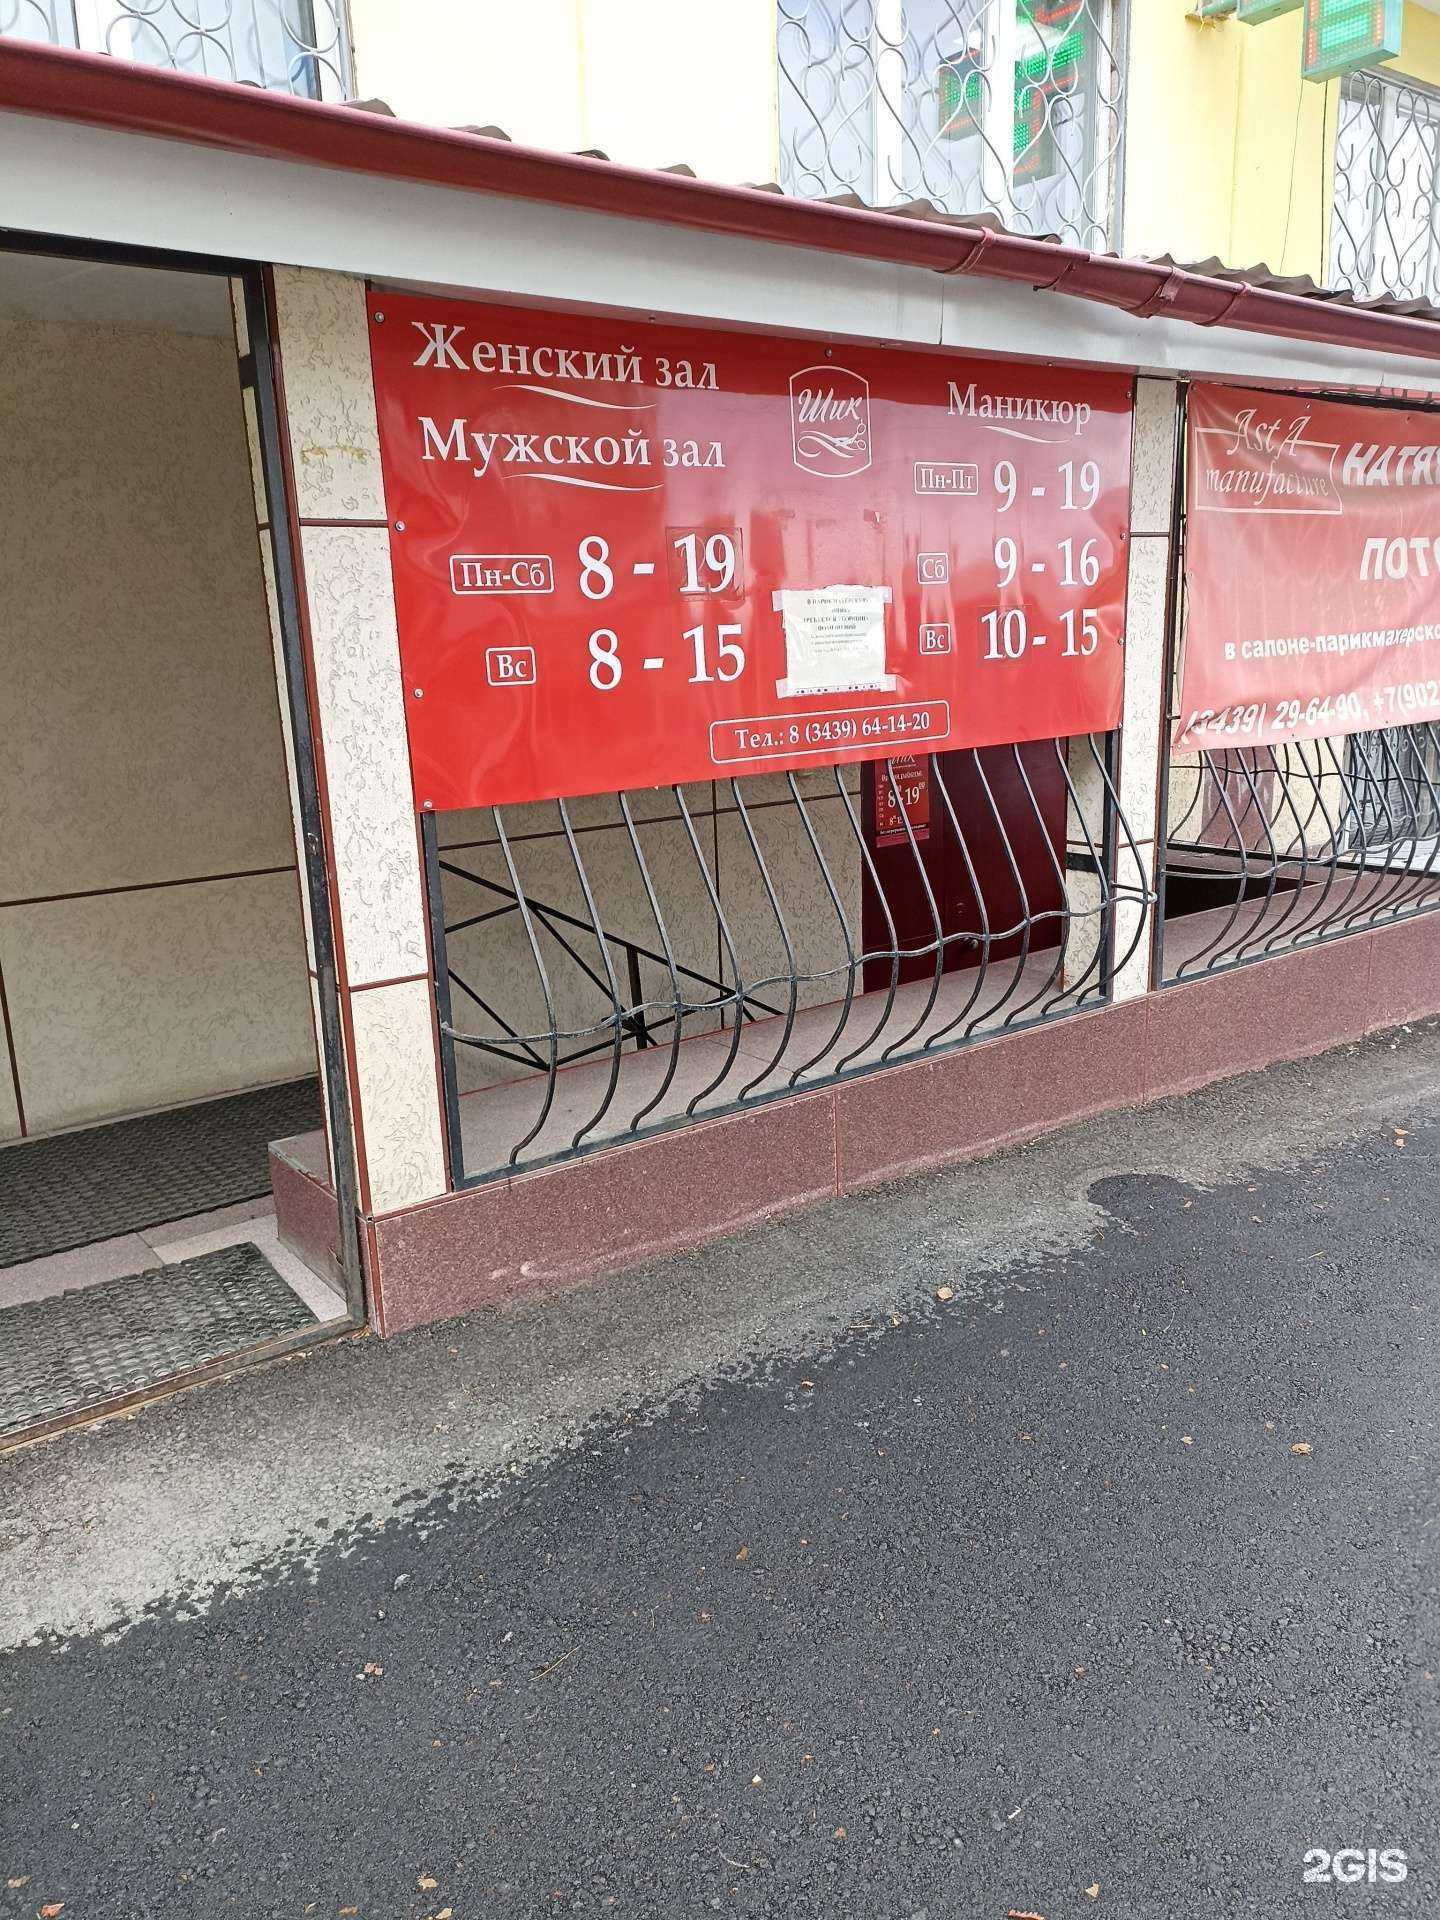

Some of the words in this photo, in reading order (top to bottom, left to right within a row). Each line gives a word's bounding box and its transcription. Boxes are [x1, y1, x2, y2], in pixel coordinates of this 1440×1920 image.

[411, 321, 644, 384] Женский
[655, 356, 720, 390] зал
[798, 387, 863, 424] Шик
[947, 381, 1091, 436] Маникюр
[418, 416, 651, 478] Мужской
[663, 438, 726, 468] зал
[920, 468, 974, 489] Пн-Пт
[993, 460, 1017, 513] 9
[1057, 460, 1100, 512] 19
[1206, 459, 1329, 506] manufacture
[460, 560, 545, 587] Пн-Сб
[578, 535, 614, 600] 8
[674, 533, 736, 593] 19
[922, 556, 945, 579] Сб
[993, 536, 1017, 588] 9
[1057, 537, 1099, 587] 16
[925, 629, 945, 650] Вс
[1059, 608, 1099, 657] 15
[1224, 643, 1236, 659] в
[496, 654, 528, 679] Вс
[588, 628, 622, 690] 8
[682, 623, 746, 683] 15
[734, 728, 784, 750] Тел.:
[789, 724, 799, 744] 8
[805, 718, 857, 744] (3439)
[862, 711, 930, 737] 64-14-20
